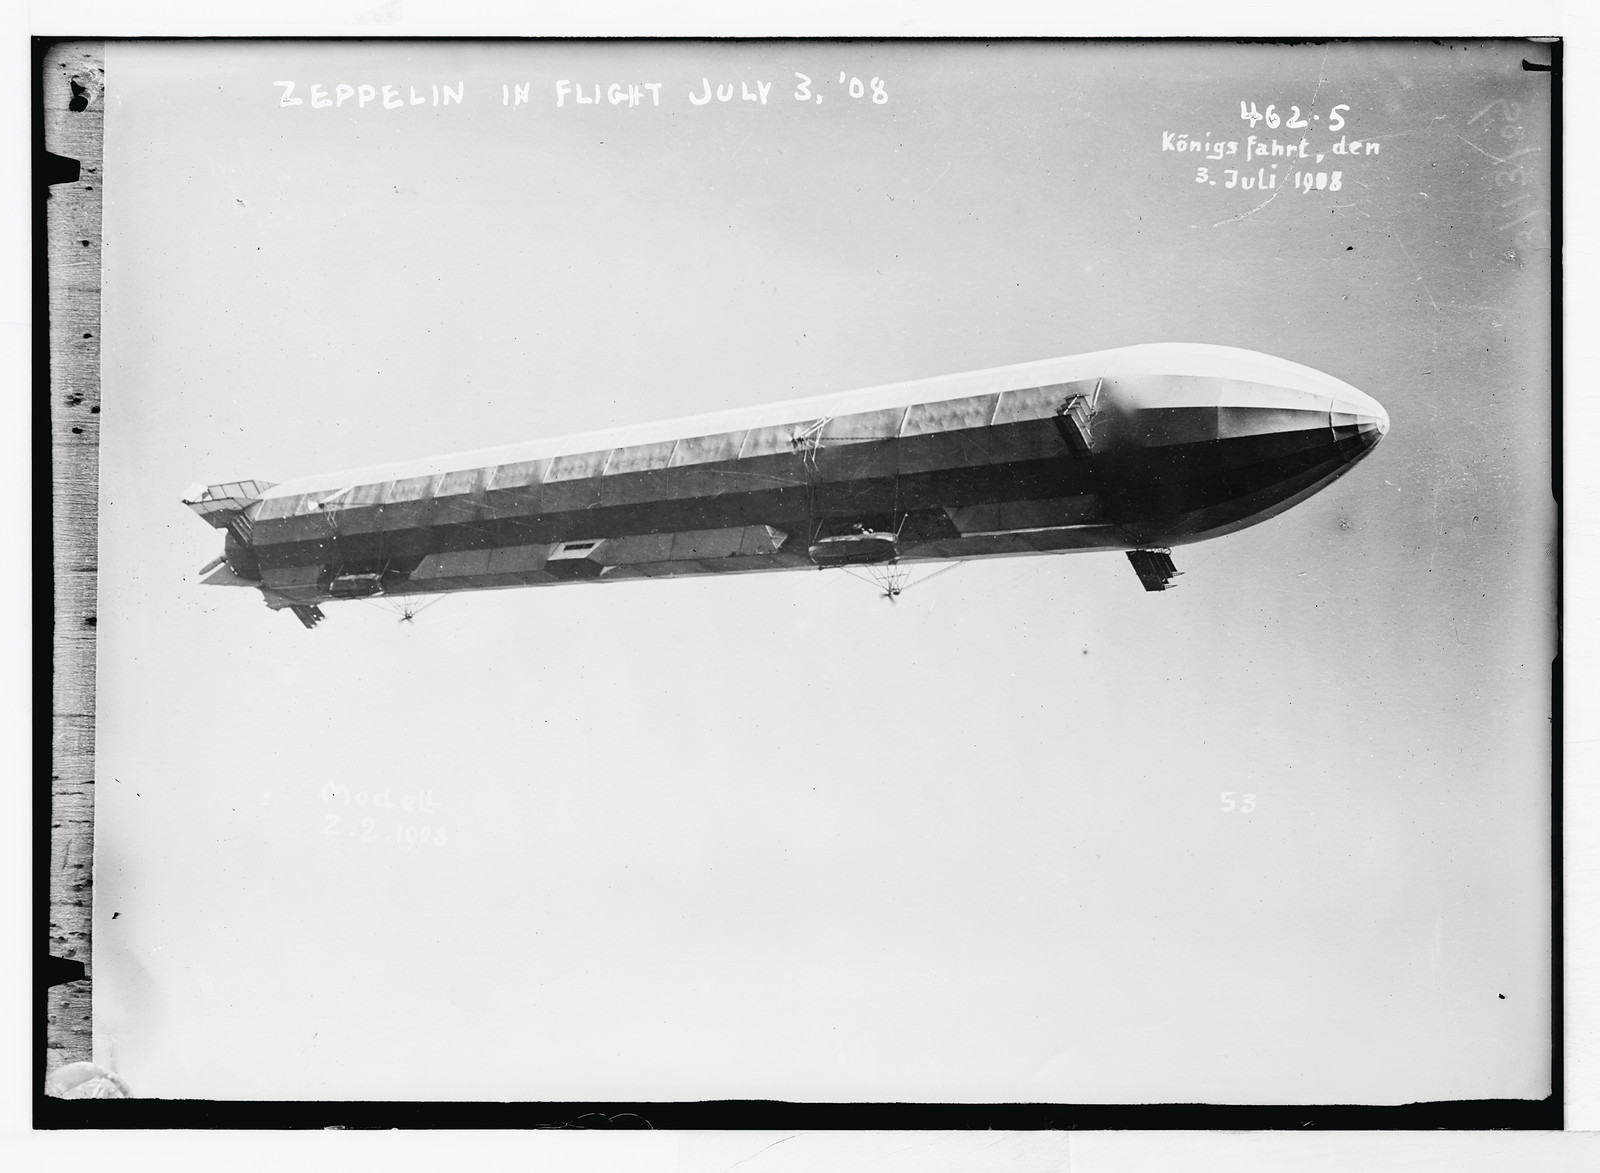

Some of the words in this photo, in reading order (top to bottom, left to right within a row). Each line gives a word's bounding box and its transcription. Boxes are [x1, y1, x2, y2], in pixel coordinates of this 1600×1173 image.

[273, 80, 465, 109] ZEPPELIN
[502, 81, 531, 107] IN
[555, 80, 662, 108] FLIGHT
[689, 77, 772, 106] JULY
[794, 72, 824, 105] 3,
[1332, 135, 1380, 155] den
[1195, 166, 1217, 186] 3.
[1224, 163, 1276, 190] Juli
[1295, 170, 1343, 194] 1908
[1219, 791, 1257, 814] 53
